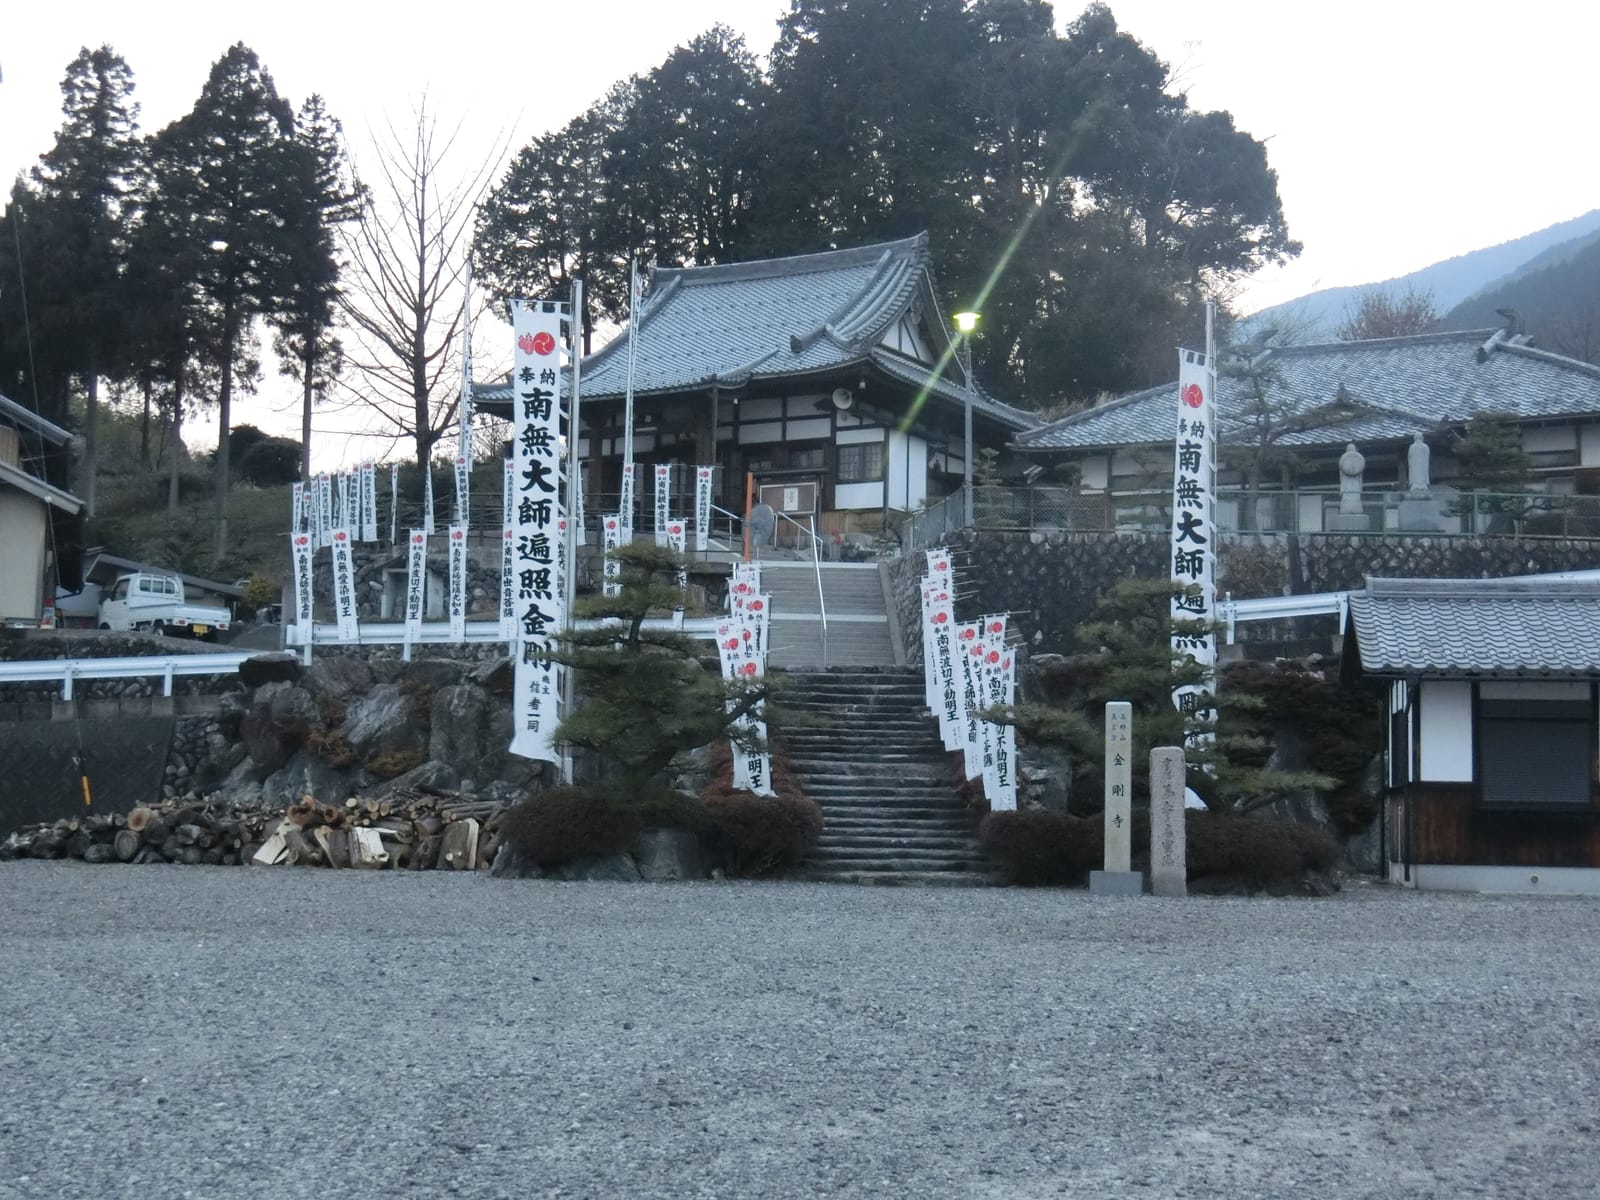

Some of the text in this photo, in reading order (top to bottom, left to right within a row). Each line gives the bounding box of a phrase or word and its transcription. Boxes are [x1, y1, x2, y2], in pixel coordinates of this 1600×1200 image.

[517, 387, 556, 673] 南無大師遍照金剛
[1111, 752, 1126, 829] 金剛寺
